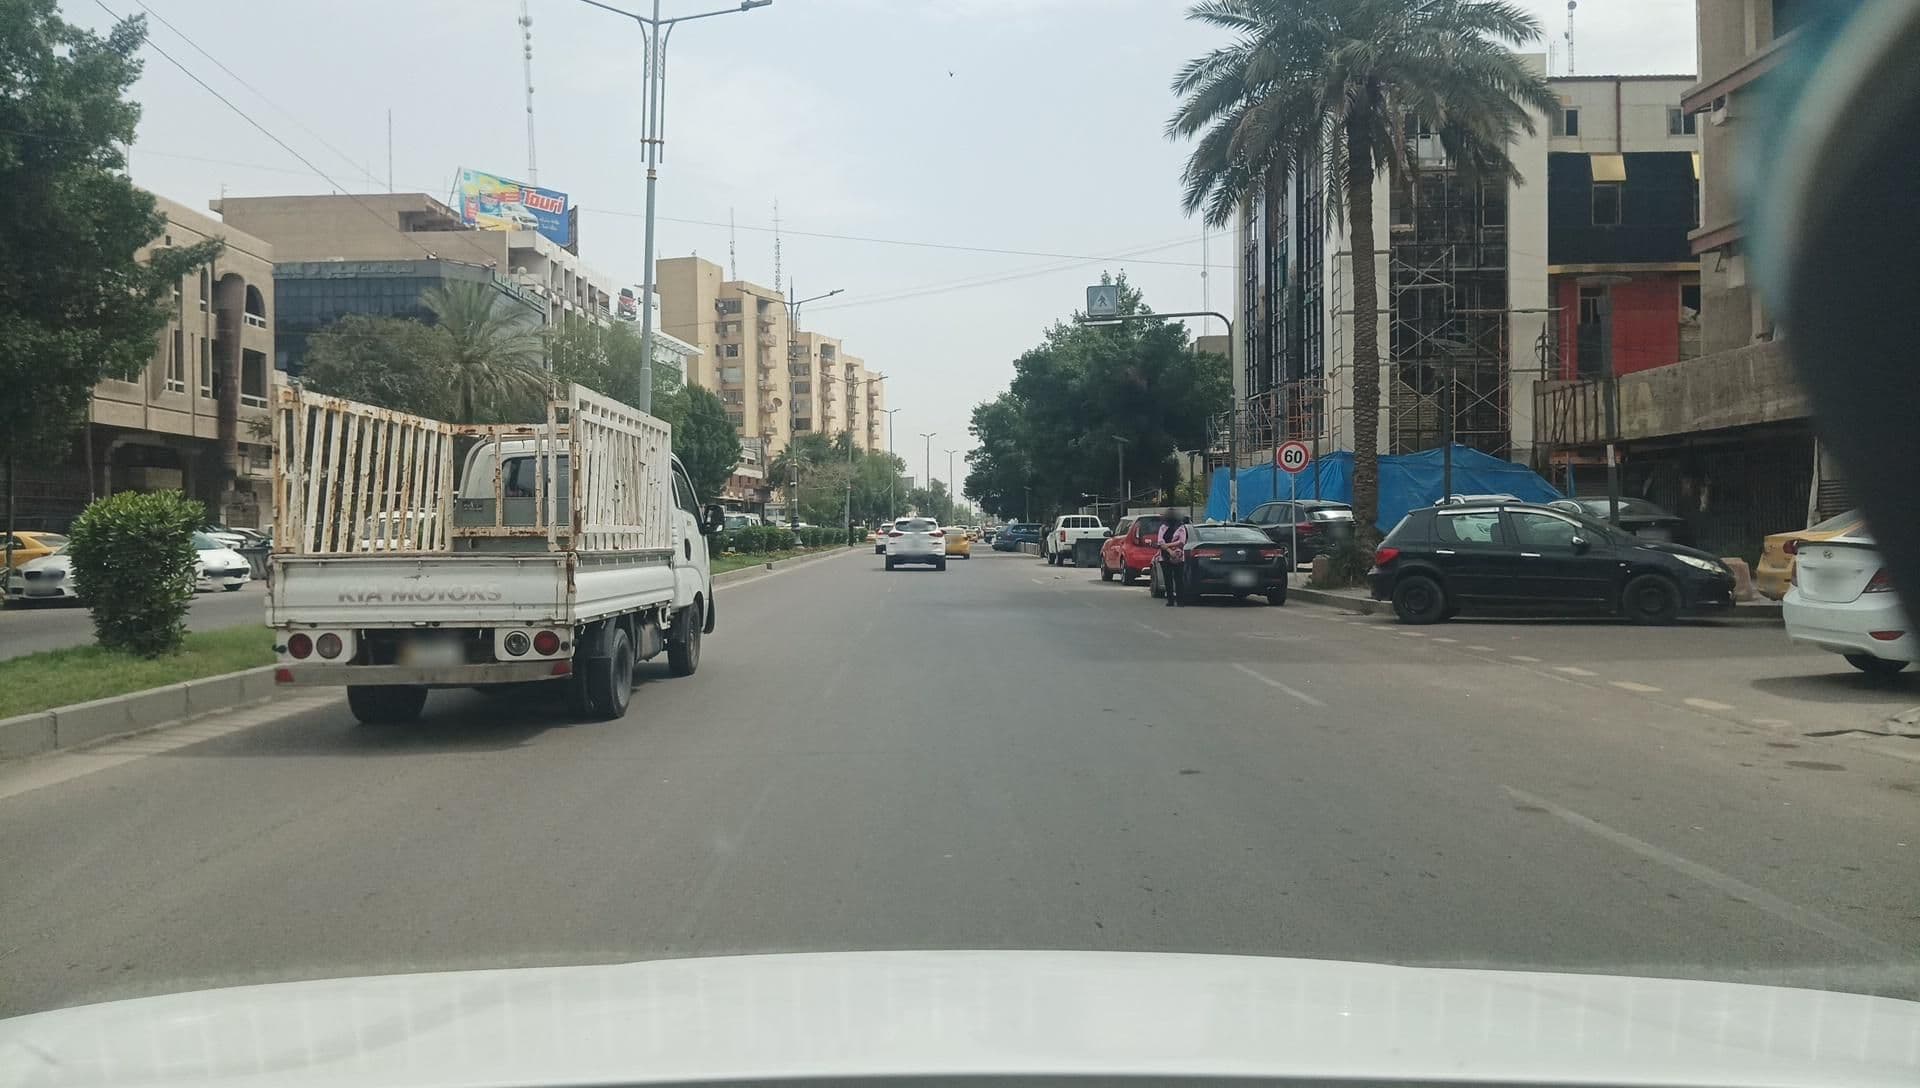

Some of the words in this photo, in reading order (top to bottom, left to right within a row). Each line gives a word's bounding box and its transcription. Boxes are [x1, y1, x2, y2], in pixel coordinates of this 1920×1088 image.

[523, 188, 565, 214] Touri
[1284, 449, 1302, 463] 60
[338, 586, 383, 602] KIA
[391, 585, 502, 602] MOTORS
